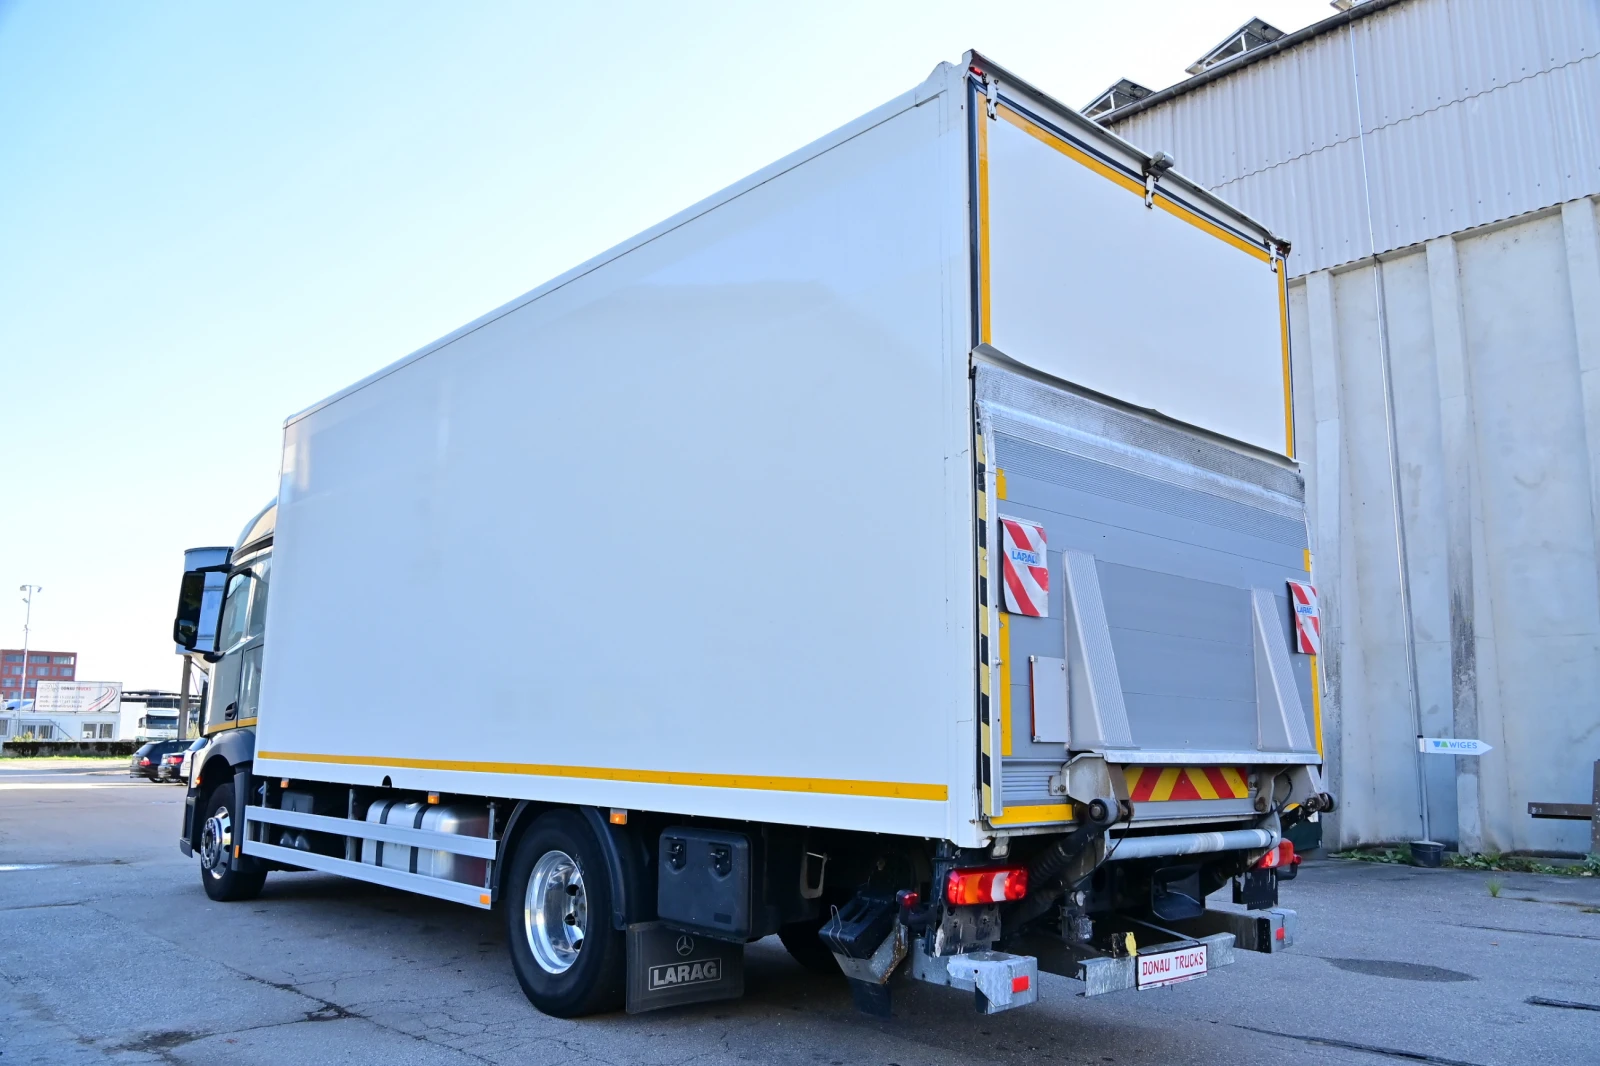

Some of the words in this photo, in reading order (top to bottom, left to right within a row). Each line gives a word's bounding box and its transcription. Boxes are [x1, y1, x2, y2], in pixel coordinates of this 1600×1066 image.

[1449, 741, 1478, 749] WIGES
[653, 961, 717, 987] LARAG
[1142, 957, 1171, 976] DONAU
[1174, 952, 1204, 970] TRUCKS
